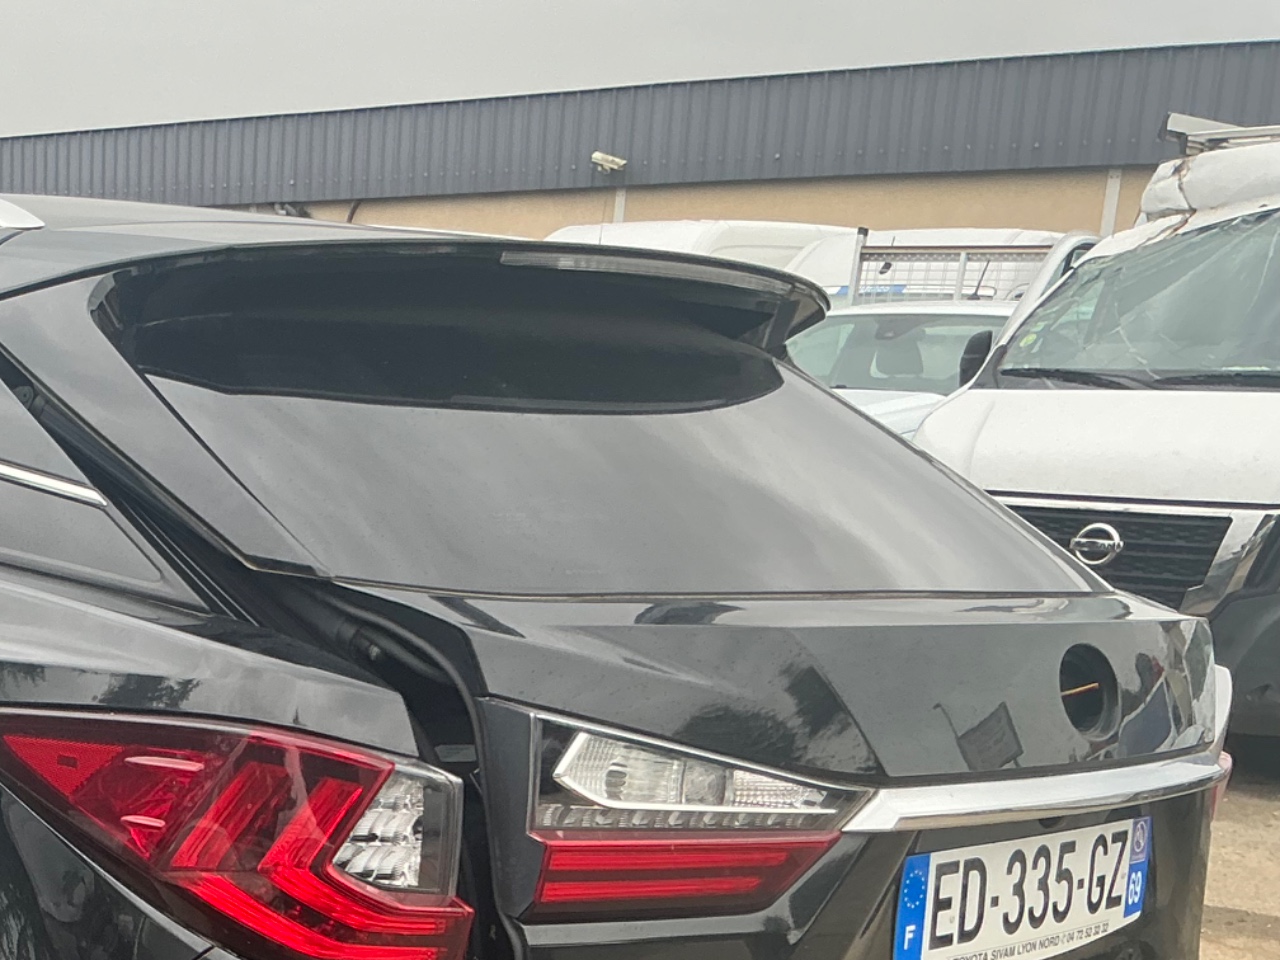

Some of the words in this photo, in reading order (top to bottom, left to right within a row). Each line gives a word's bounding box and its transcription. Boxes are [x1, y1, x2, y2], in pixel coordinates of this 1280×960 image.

[928, 829, 1129, 951] ED-335-GZ
[1128, 870, 1143, 905] 69
[903, 924, 916, 950] F
[1017, 940, 1037, 956] LYON
[1038, 935, 1060, 950] NORD
